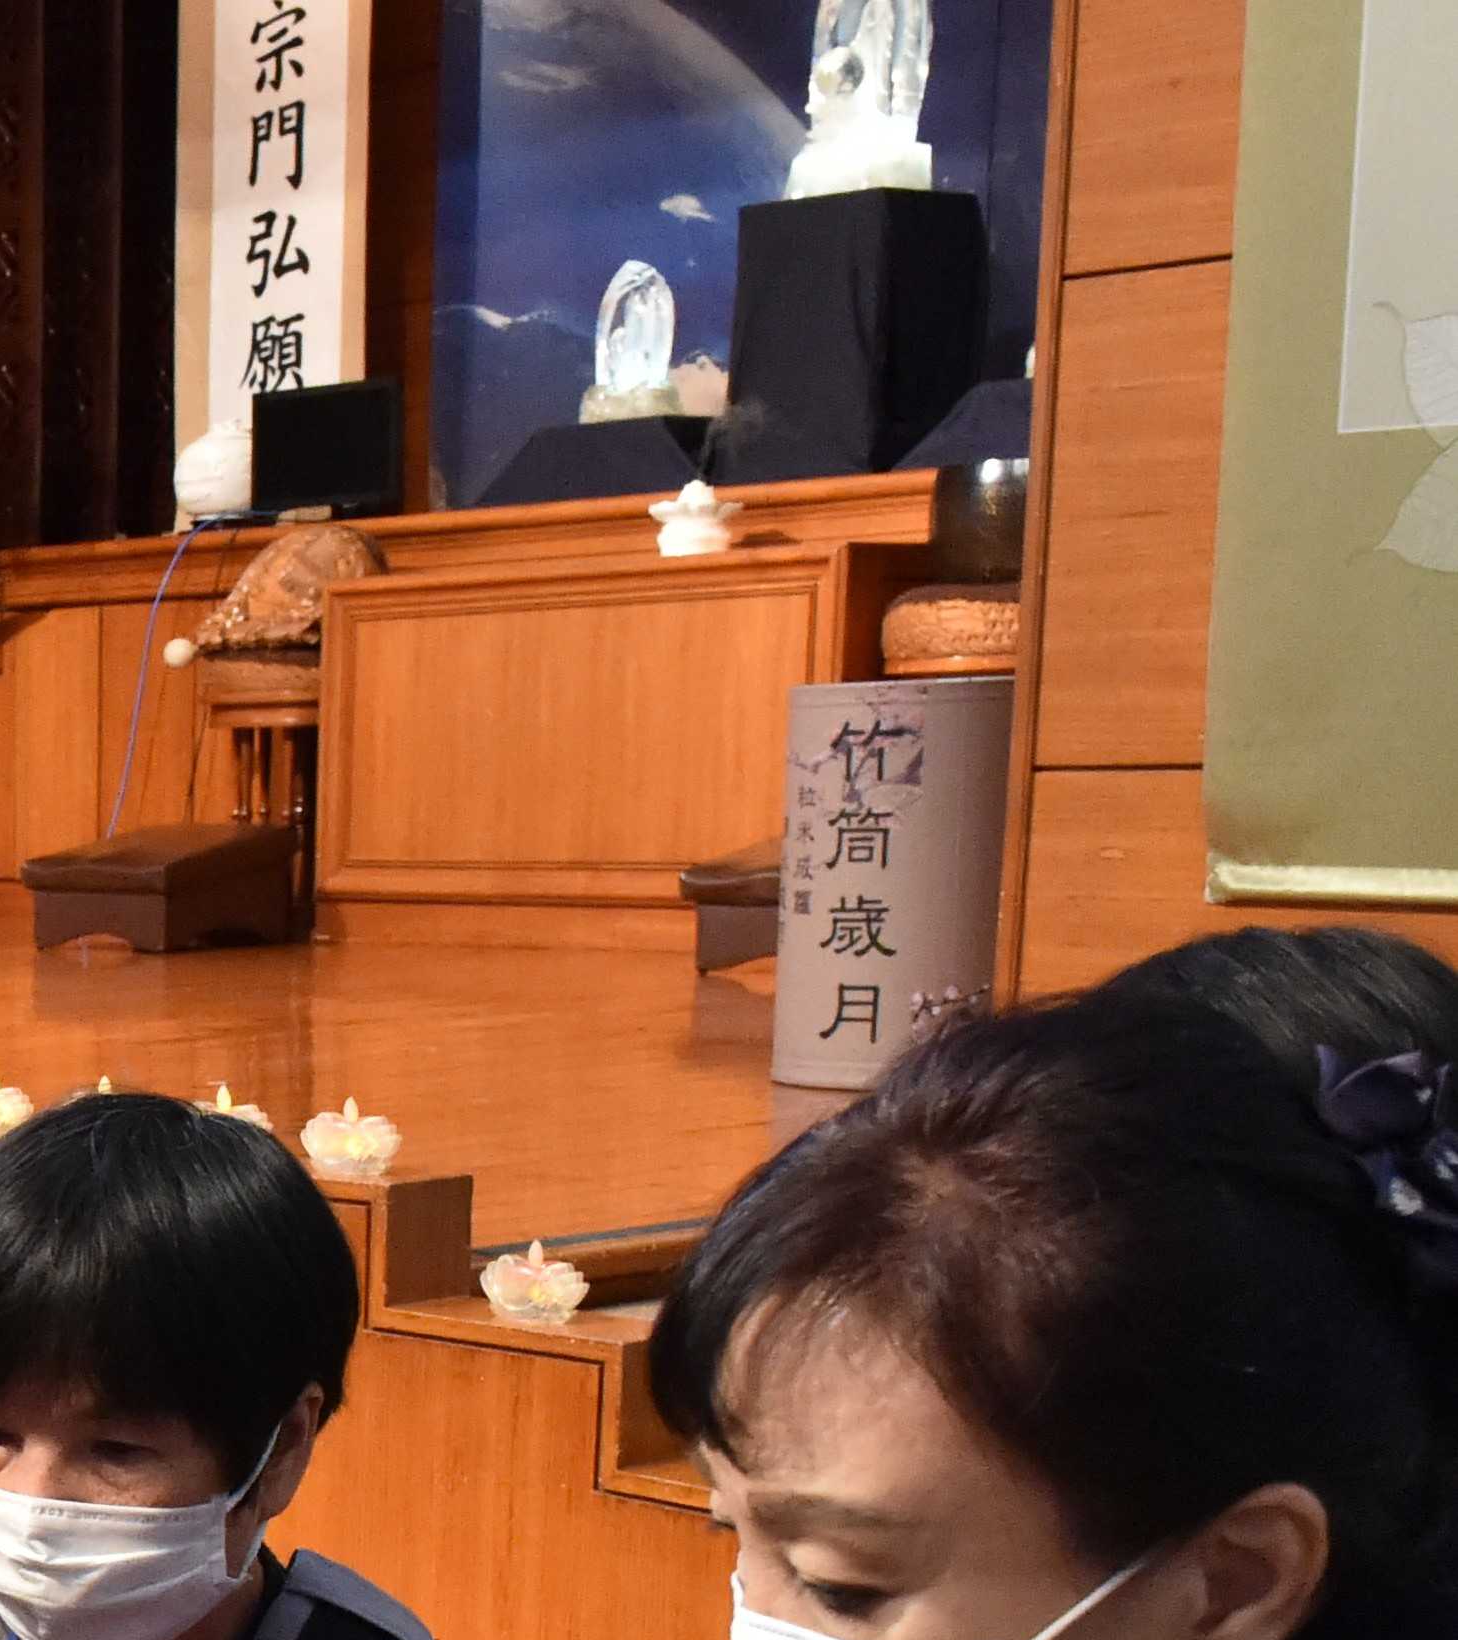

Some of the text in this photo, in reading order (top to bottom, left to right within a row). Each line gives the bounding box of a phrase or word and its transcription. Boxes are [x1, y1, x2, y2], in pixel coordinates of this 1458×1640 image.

[240, 0, 310, 391] 宗門弘願
[819, 719, 898, 1043] 竹筒歲月
